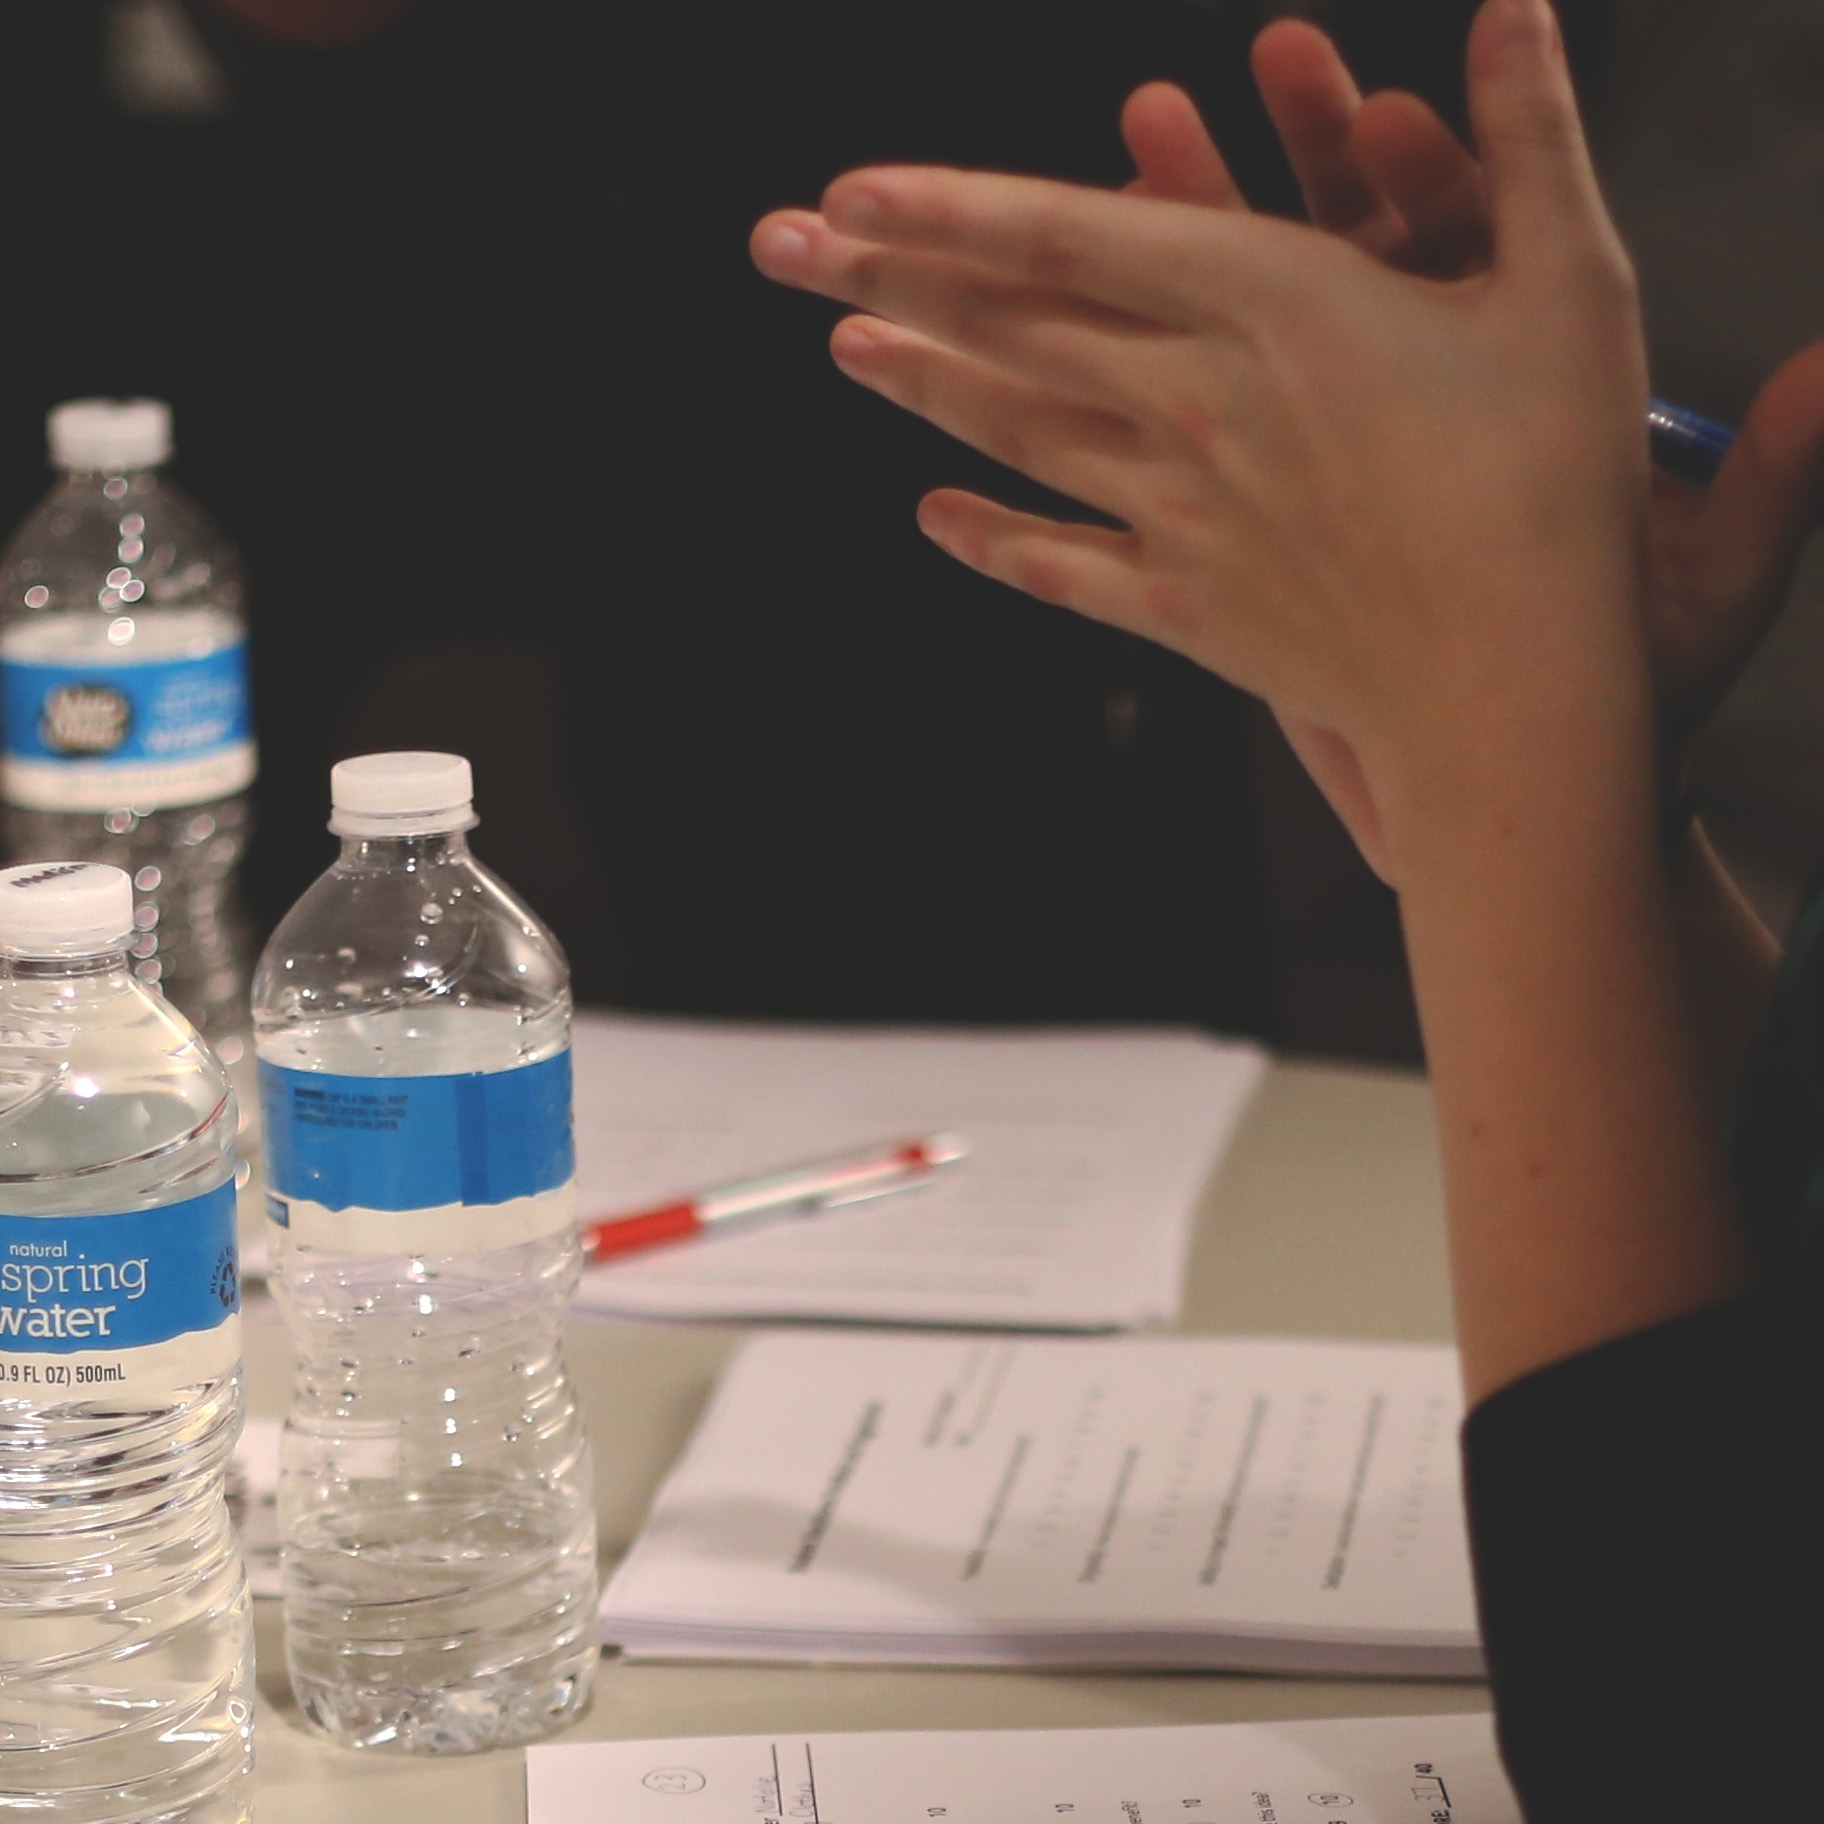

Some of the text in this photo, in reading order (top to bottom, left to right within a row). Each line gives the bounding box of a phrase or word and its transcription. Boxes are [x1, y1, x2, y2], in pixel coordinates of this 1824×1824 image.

[9, 1240, 68, 1257] natural
[0, 1254, 150, 1303] spring
[23, 1365, 42, 1384] FL
[45, 1365, 72, 1388] OZ)
[75, 1362, 127, 1384] 500mL
[1182, 1798, 1202, 1808] 10
[1251, 1791, 1270, 1808] idea?
[1319, 1795, 1339, 1805] 10
[926, 1807, 946, 1818] 10
[1054, 1803, 1074, 1813] 10
[1259, 1809, 1277, 1821] this
